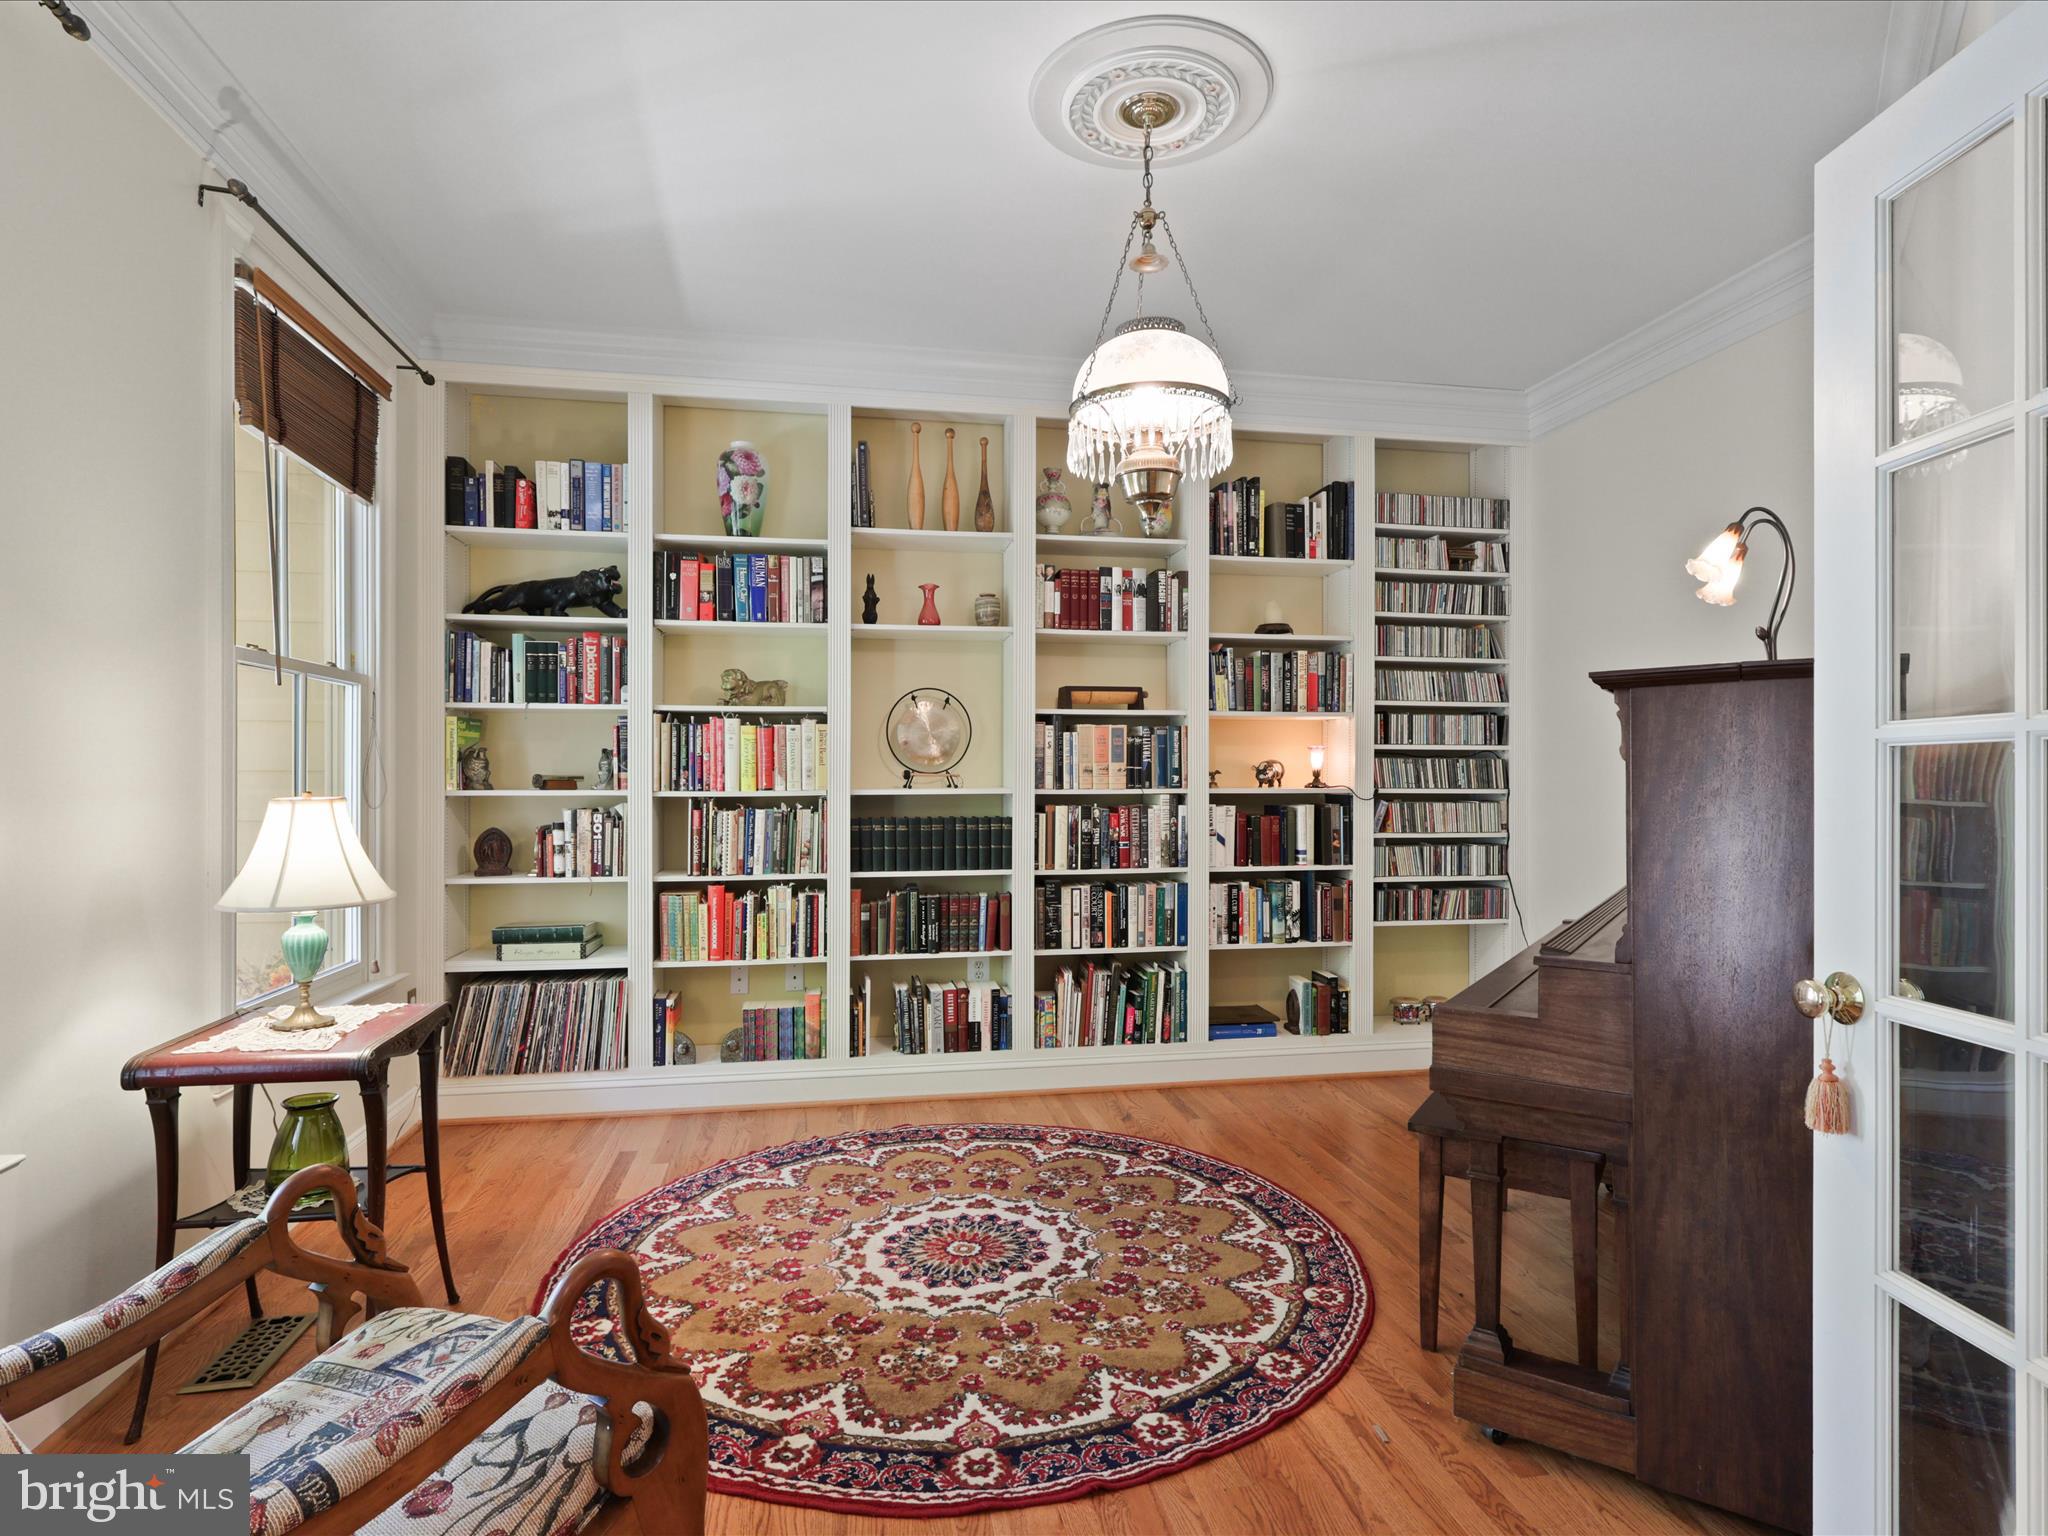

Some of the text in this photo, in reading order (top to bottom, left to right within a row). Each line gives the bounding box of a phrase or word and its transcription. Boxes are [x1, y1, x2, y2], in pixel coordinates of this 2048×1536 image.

[755, 557, 766, 587] TRUMAN
[1158, 570, 1166, 603] IMPEACHED
[585, 645, 597, 701] Dictionary
[593, 813, 602, 839] 501
[1131, 808, 1140, 846] GETTYSBURG
[693, 835, 701, 864] cookies
[933, 991, 942, 1031] MOZART
